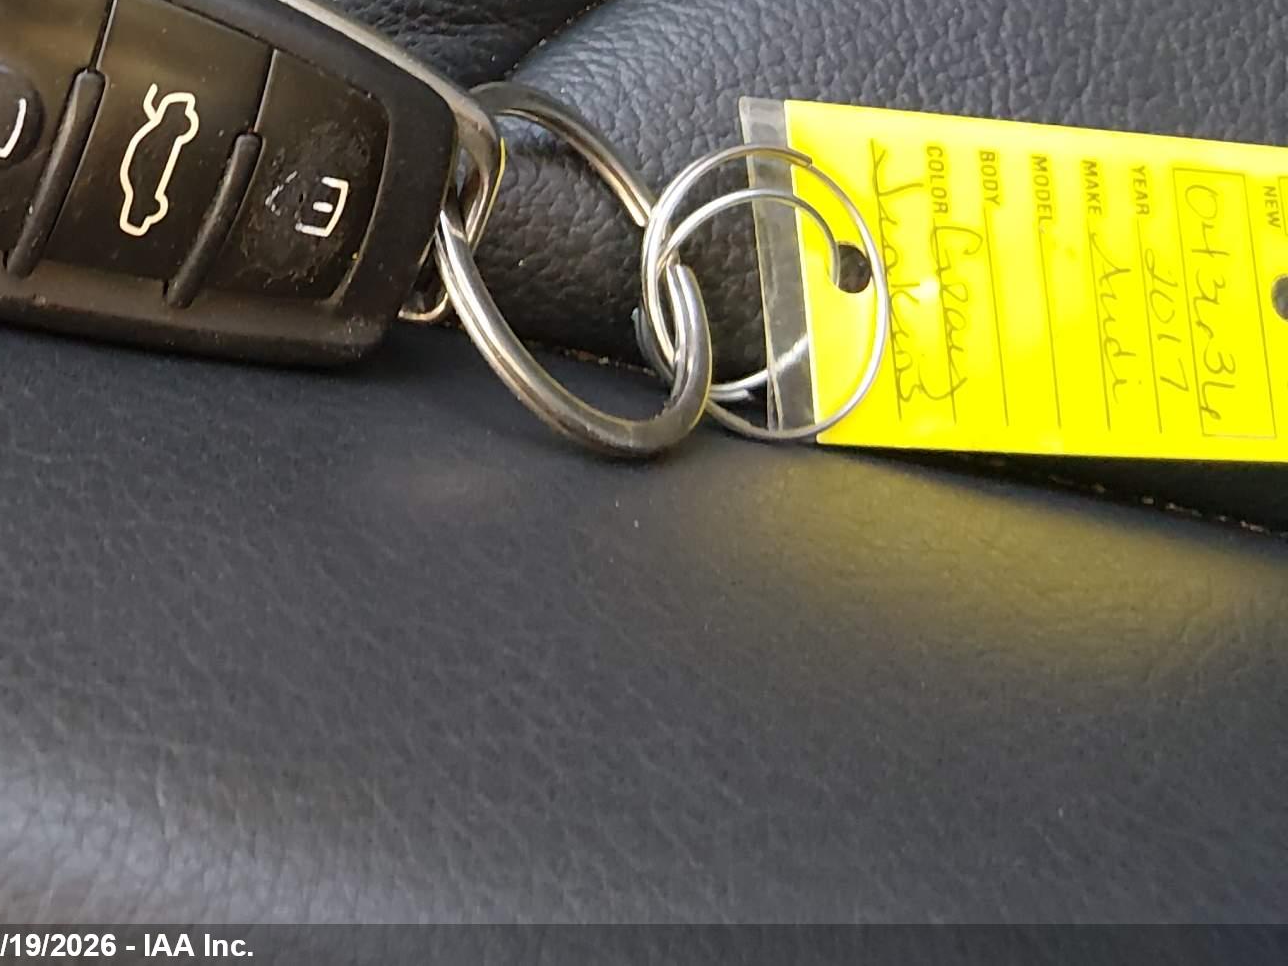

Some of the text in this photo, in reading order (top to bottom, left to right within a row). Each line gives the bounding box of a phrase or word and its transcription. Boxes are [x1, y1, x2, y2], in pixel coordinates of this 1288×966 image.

[926, 145, 948, 215] COLOR
[980, 150, 1000, 206] BODY
[1032, 155, 1053, 223] MODEL
[1082, 159, 1102, 216] MAKE
[1132, 165, 1150, 216] YEAR
[1264, 185, 1282, 228] NEW
[1089, 232, 1141, 404] Audi
[1145, 247, 1190, 392] 2017
